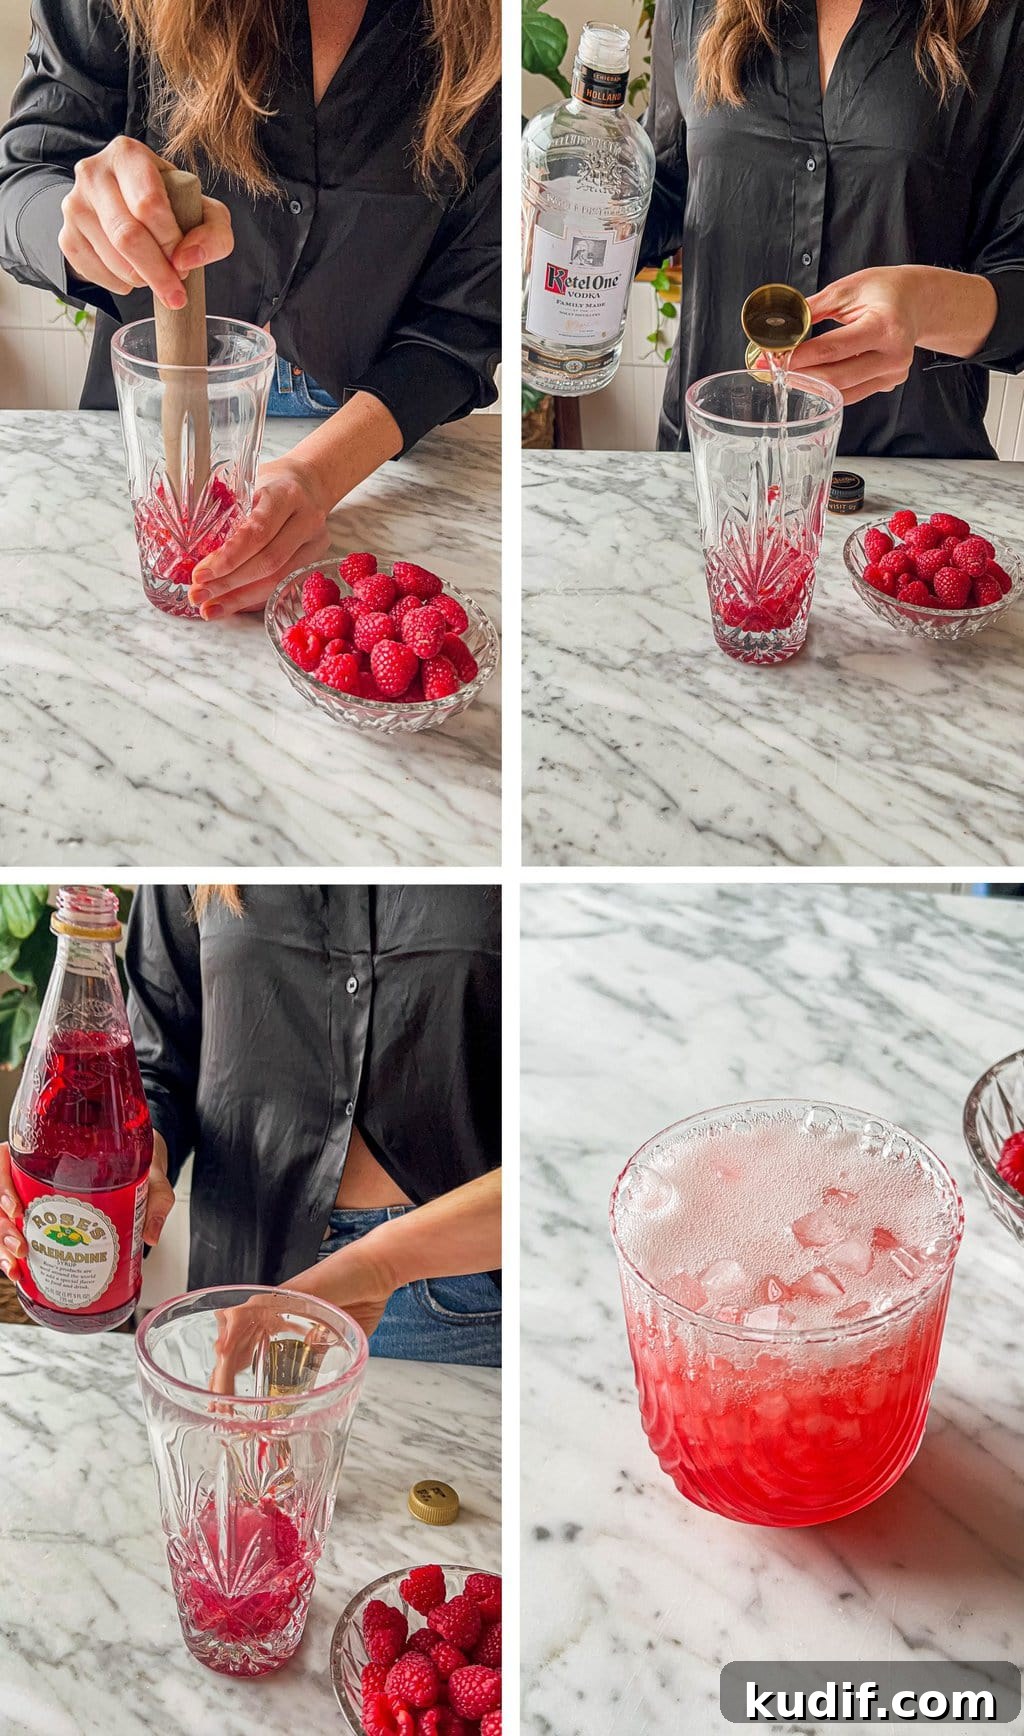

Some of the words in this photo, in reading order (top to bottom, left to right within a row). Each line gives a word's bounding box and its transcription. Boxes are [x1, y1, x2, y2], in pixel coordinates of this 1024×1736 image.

[586, 89, 622, 101] HOLLAND
[546, 264, 590, 294] Ketel
[592, 275, 619, 290] One
[556, 299, 584, 308] FAMILY
[568, 291, 601, 299] VODKA
[32, 1211, 107, 1241] ROSE'S
[31, 1239, 108, 1264] GRENADINE
